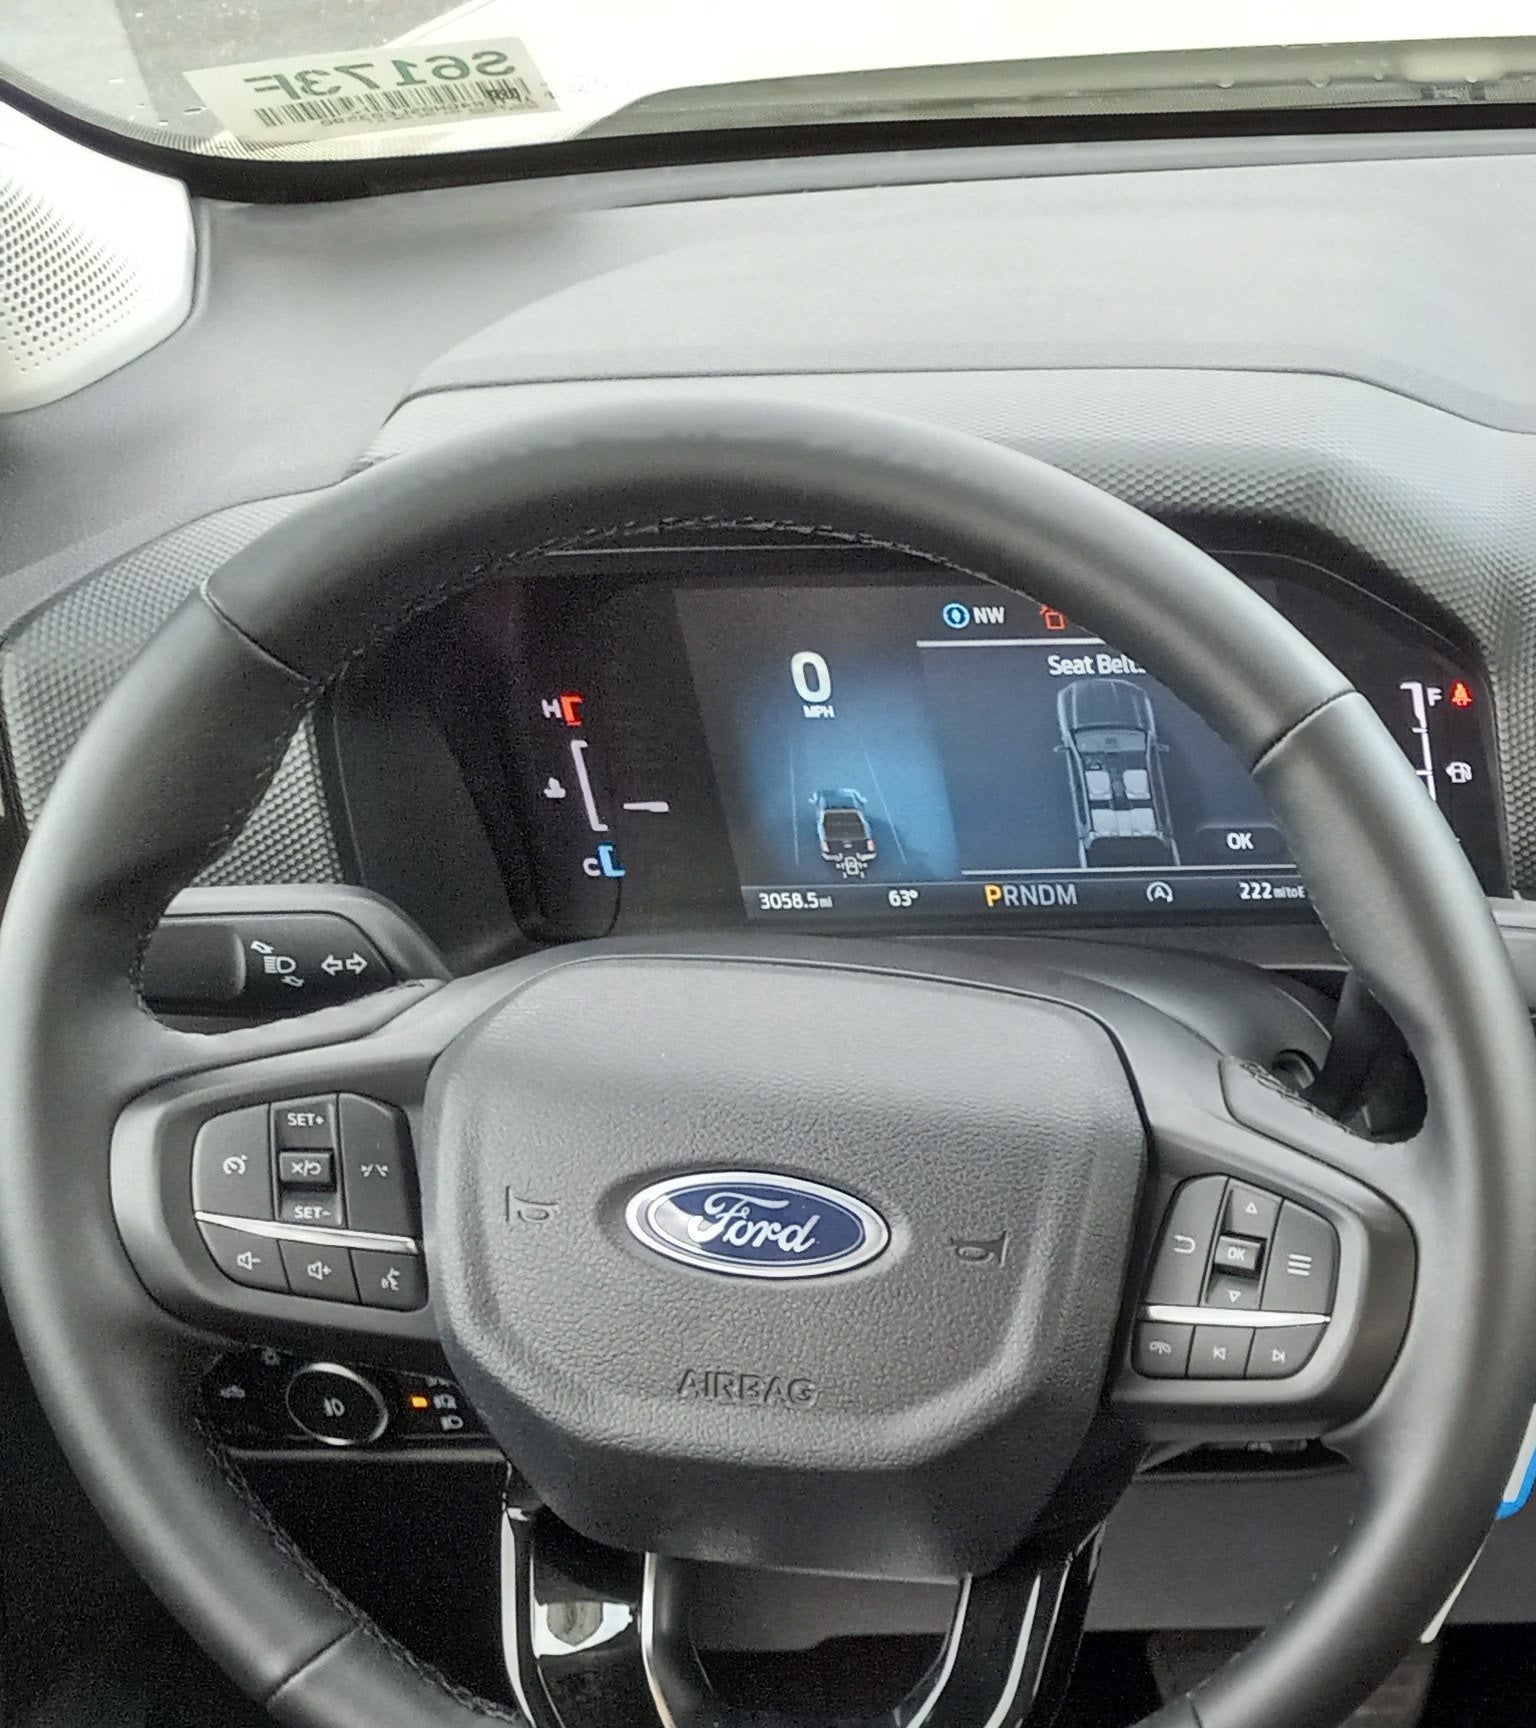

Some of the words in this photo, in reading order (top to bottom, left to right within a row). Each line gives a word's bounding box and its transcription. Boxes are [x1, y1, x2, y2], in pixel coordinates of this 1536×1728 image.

[974, 607, 1005, 625] NW
[1047, 654, 1095, 676] Seat
[1096, 653, 1147, 675] Belt
[791, 652, 832, 703] 0
[1428, 687, 1442, 706] F
[804, 705, 835, 719] MPH
[1227, 833, 1254, 850] OK
[1239, 881, 1273, 900] 222
[686, 1191, 820, 1254] Ford
[1227, 1247, 1245, 1262] OK
[676, 1369, 819, 1405] AIRBAG
